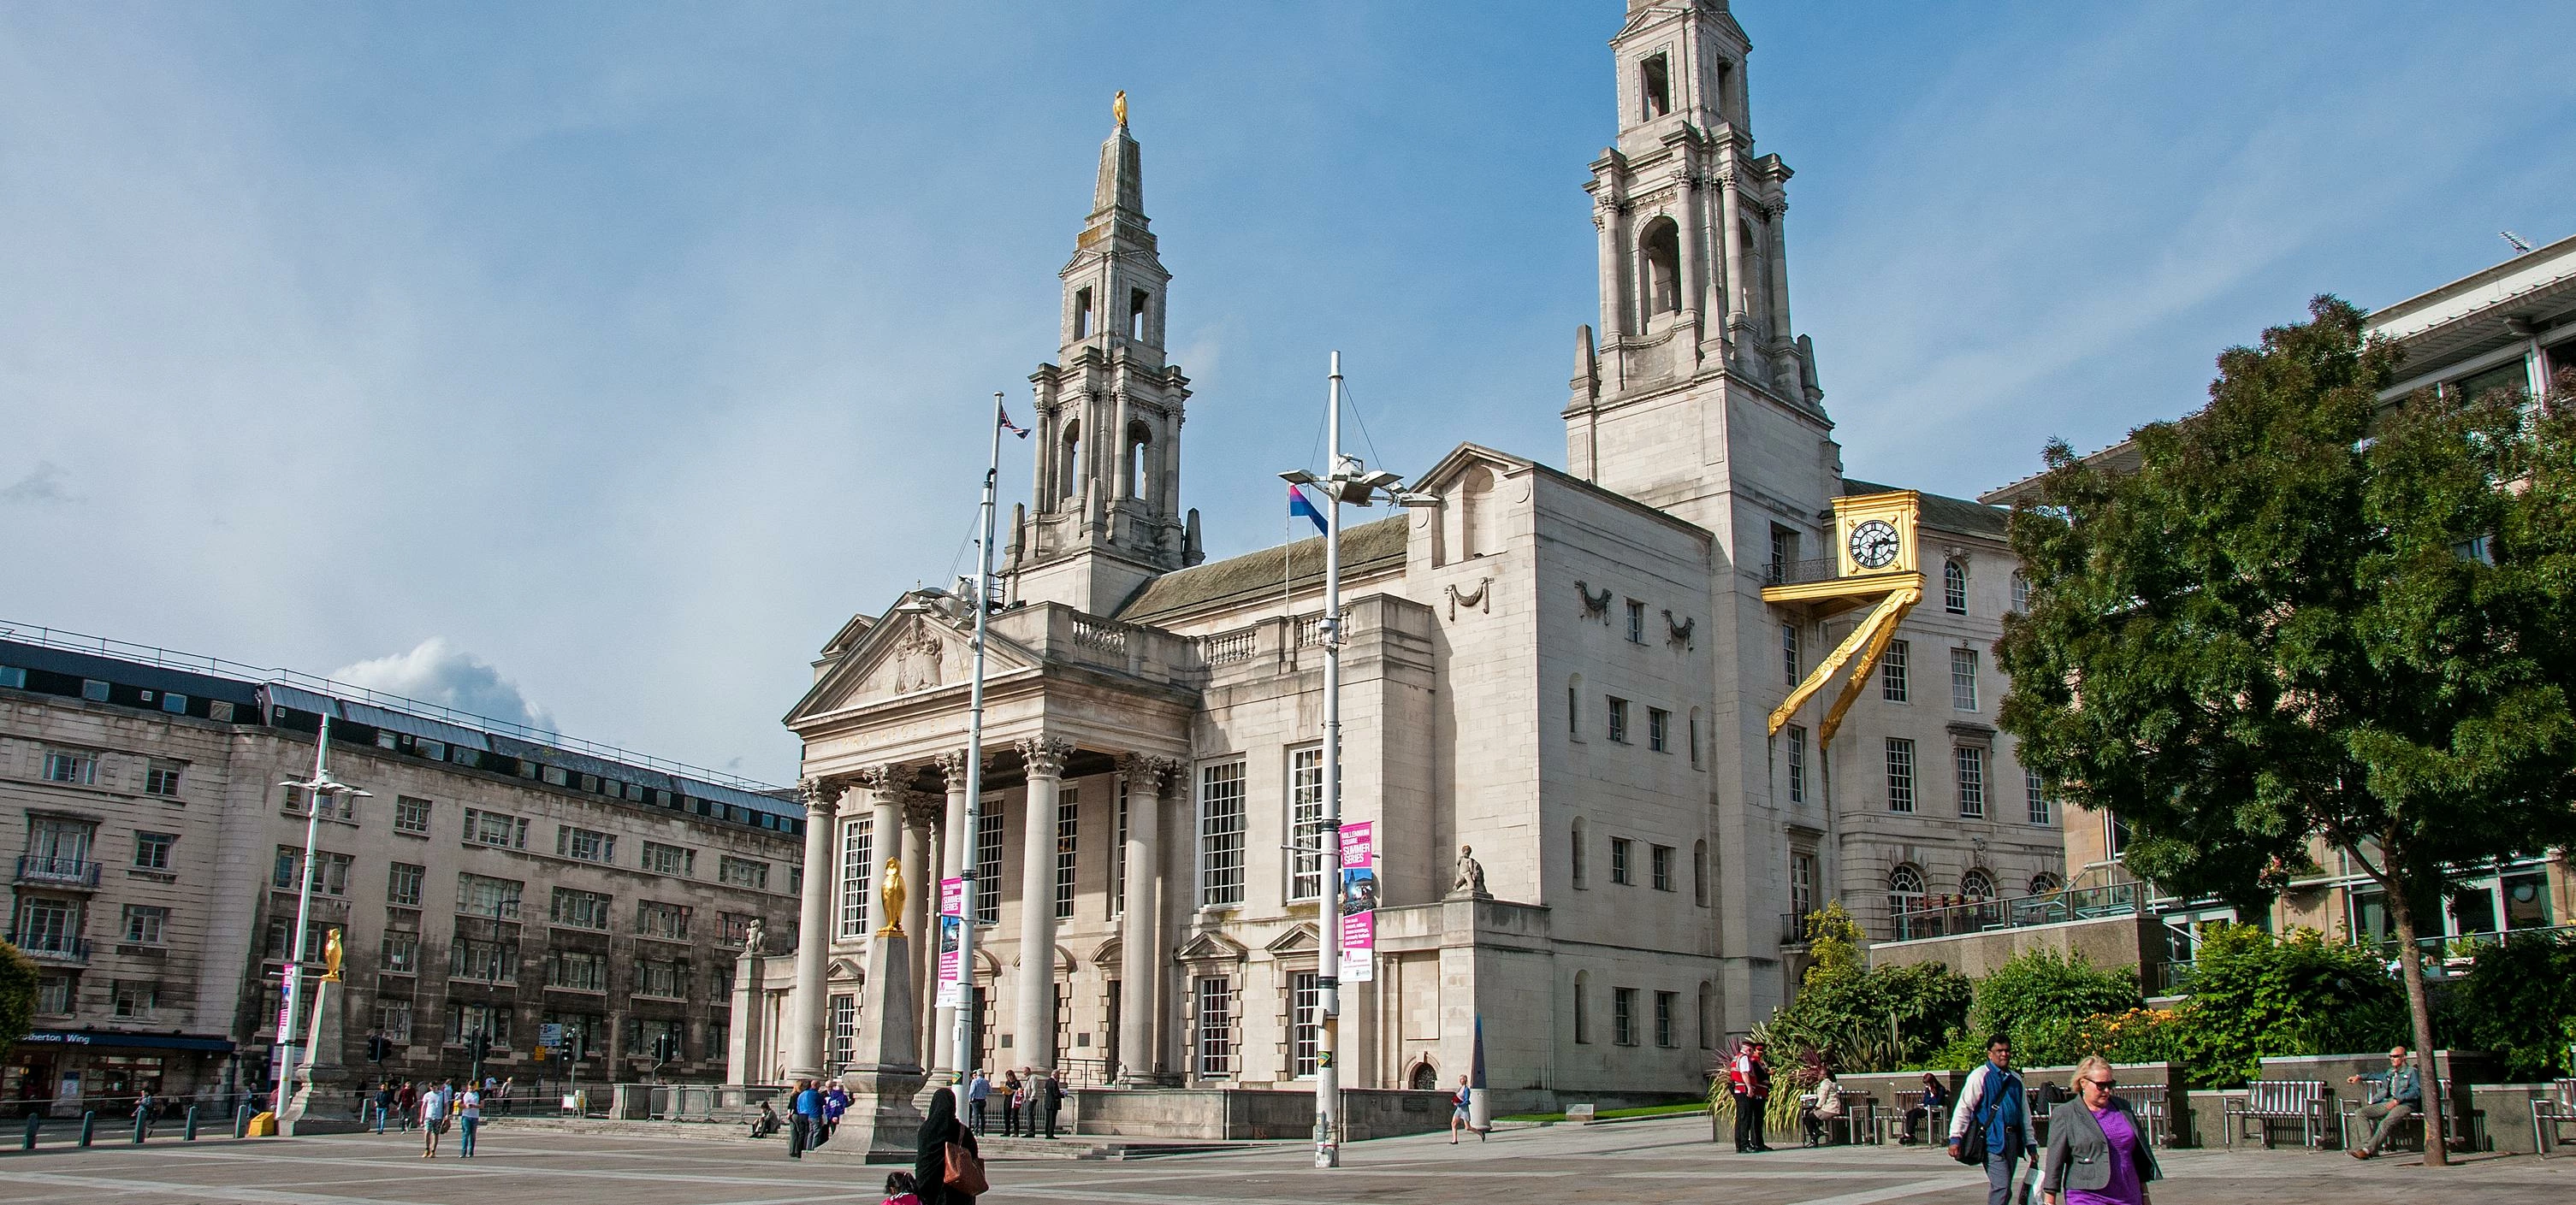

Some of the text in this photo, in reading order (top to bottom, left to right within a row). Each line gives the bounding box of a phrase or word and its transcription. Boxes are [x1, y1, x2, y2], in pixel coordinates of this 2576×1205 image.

[1342, 842, 1371, 856] SUMMER
[1344, 853, 1364, 865] SERIES
[66, 1033, 91, 1045] Wing
